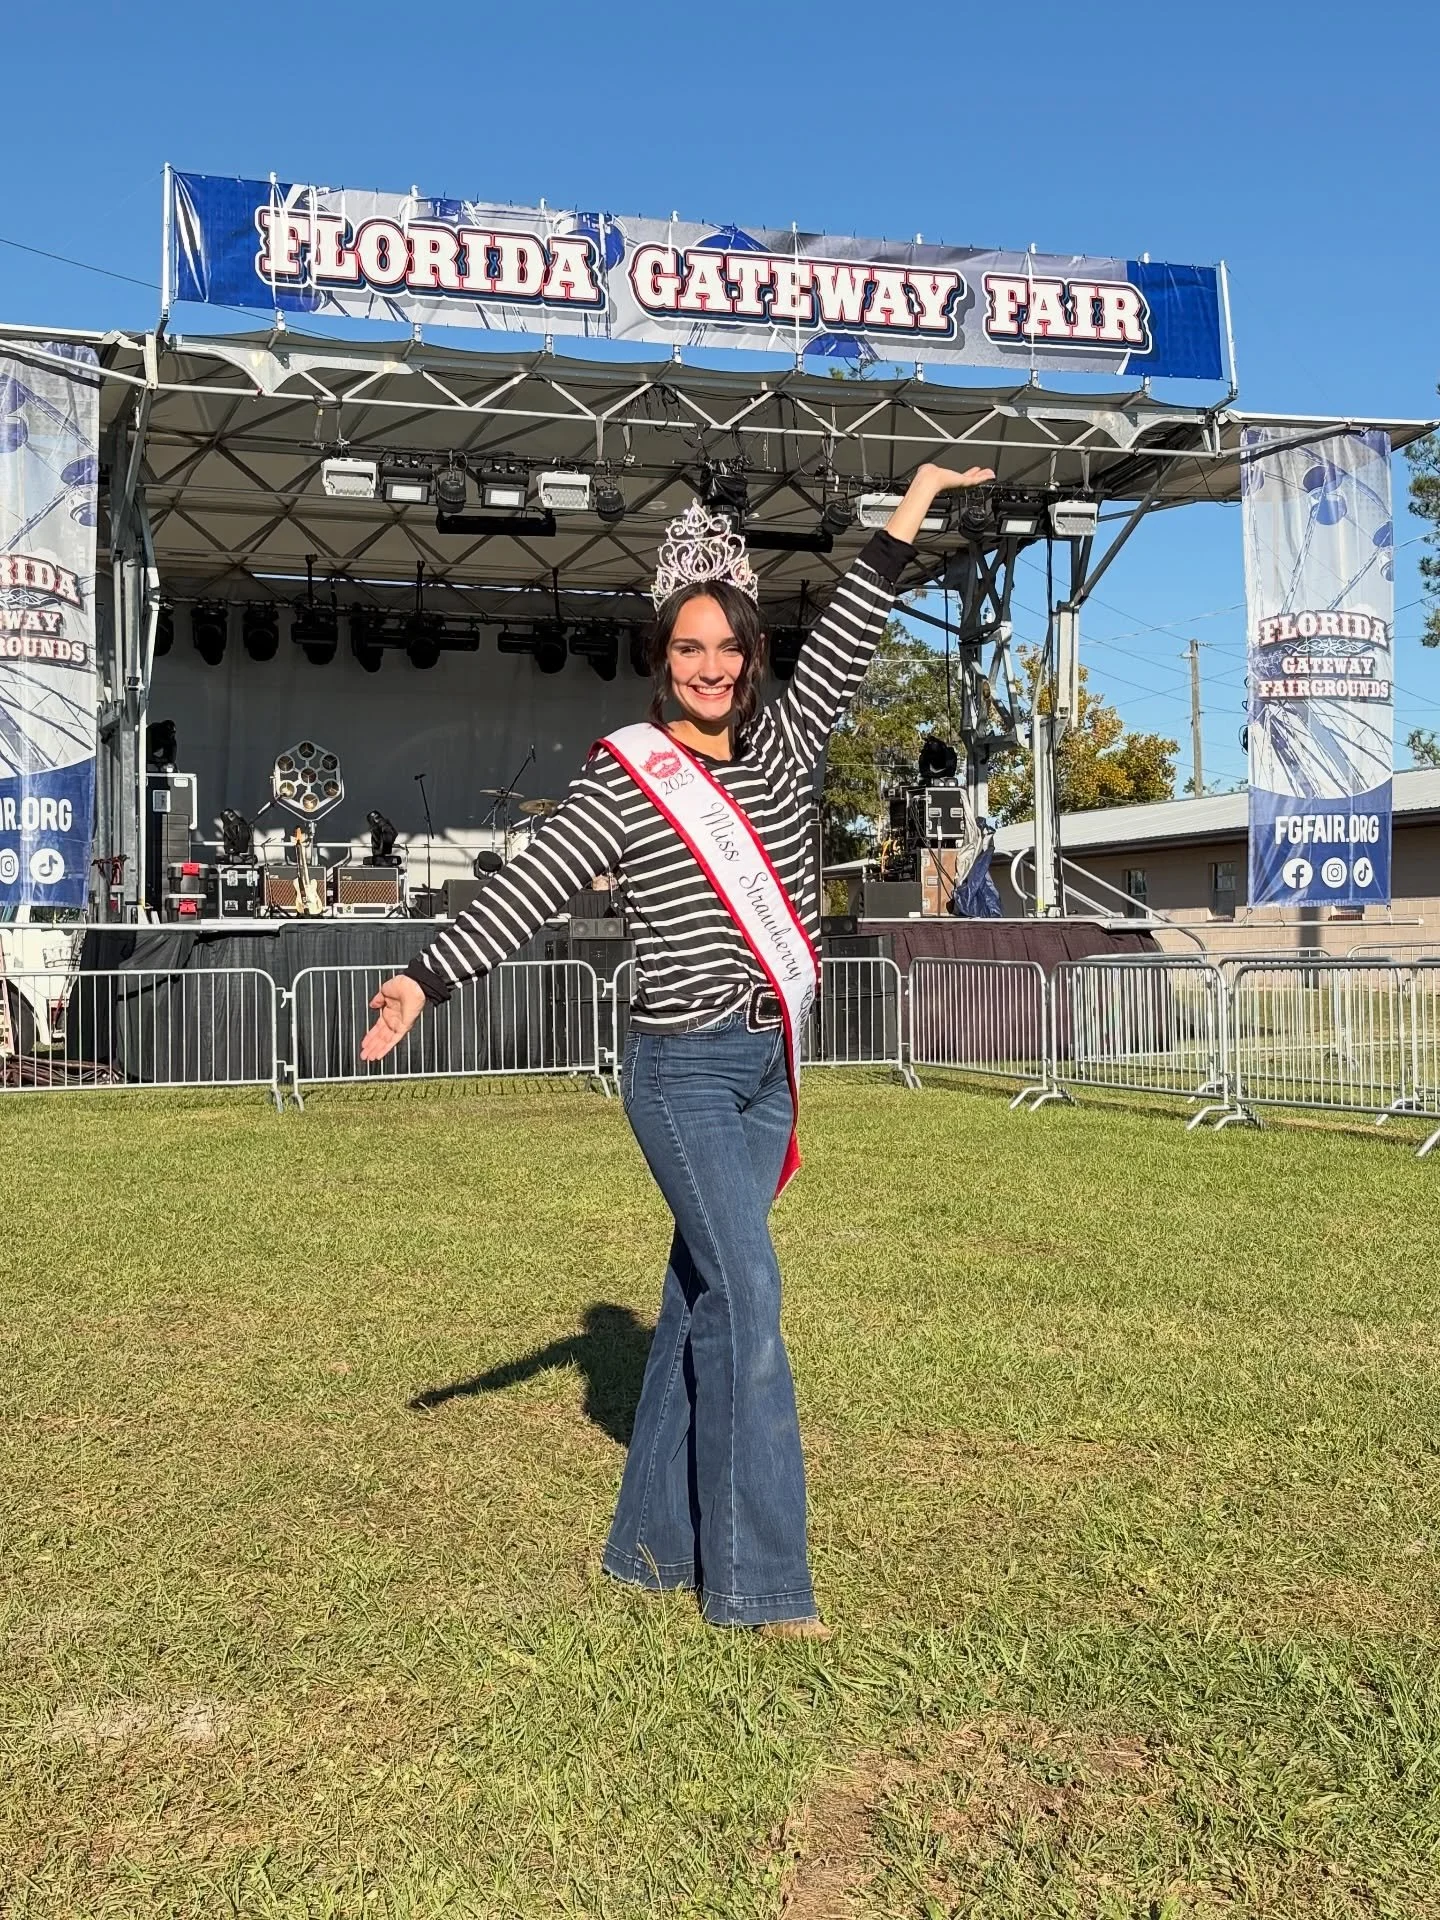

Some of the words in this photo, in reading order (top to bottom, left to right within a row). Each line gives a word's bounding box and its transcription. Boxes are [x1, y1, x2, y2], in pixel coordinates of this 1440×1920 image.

[258, 210, 602, 304] FLORIDA
[631, 248, 962, 332] GATEWAY
[986, 273, 1147, 344] FAIR
[1258, 610, 1388, 649] FLORIDA
[1282, 657, 1374, 676] GATEWAY
[1258, 680, 1390, 699] FAIRGROUNDS
[660, 768, 695, 796] 2025
[1275, 814, 1380, 845] FGFAIR.ORG
[699, 801, 741, 862] Miss
[738, 871, 802, 982] Strawberry
